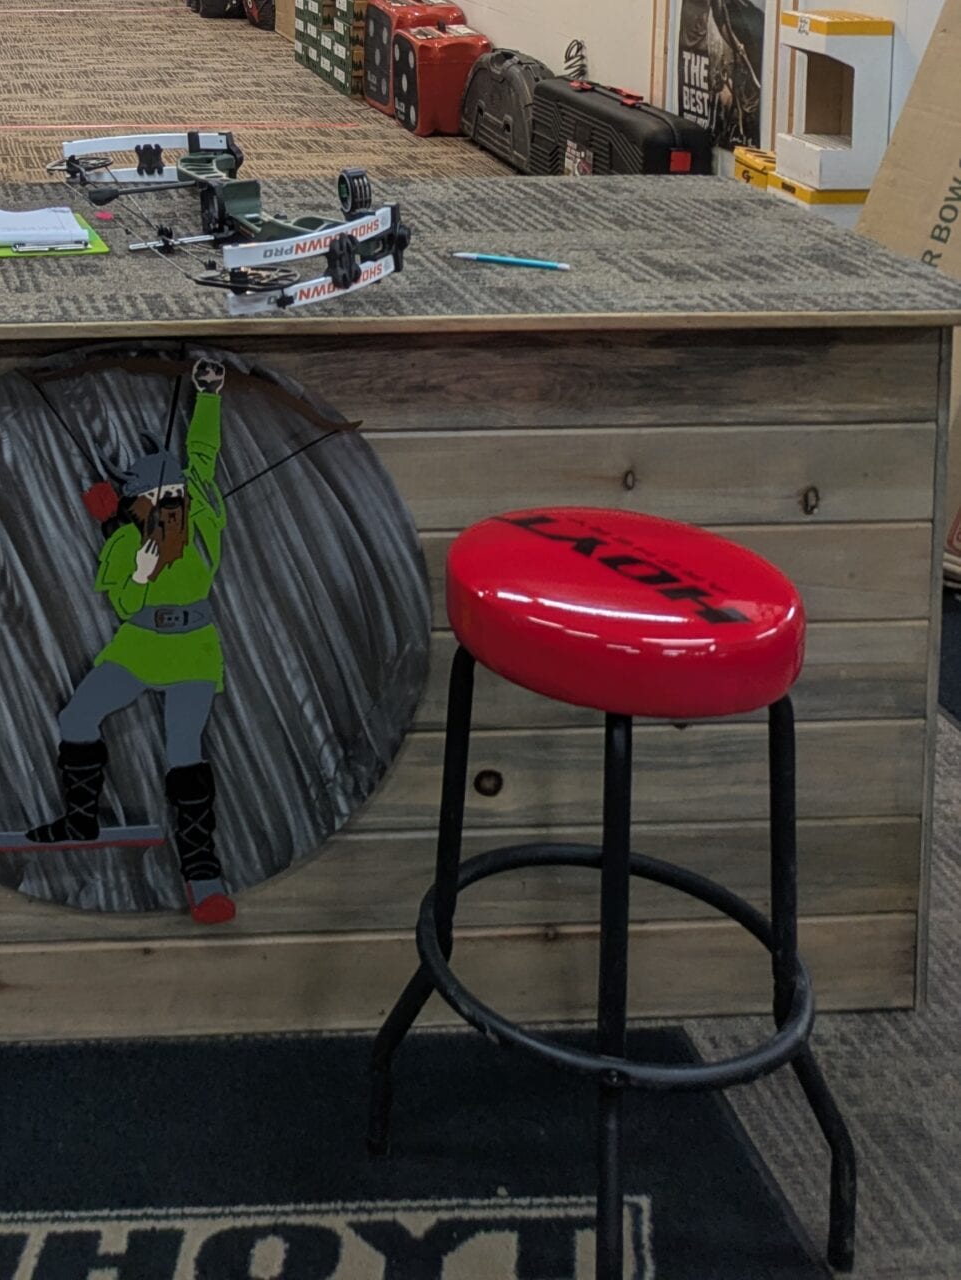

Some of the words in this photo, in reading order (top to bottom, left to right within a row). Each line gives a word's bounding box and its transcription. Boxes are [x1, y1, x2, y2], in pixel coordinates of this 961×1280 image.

[682, 50, 710, 91] THE
[682, 85, 710, 117] BEST
[294, 219, 380, 255] SHOOOWN
[489, 515, 753, 625] HOYT
